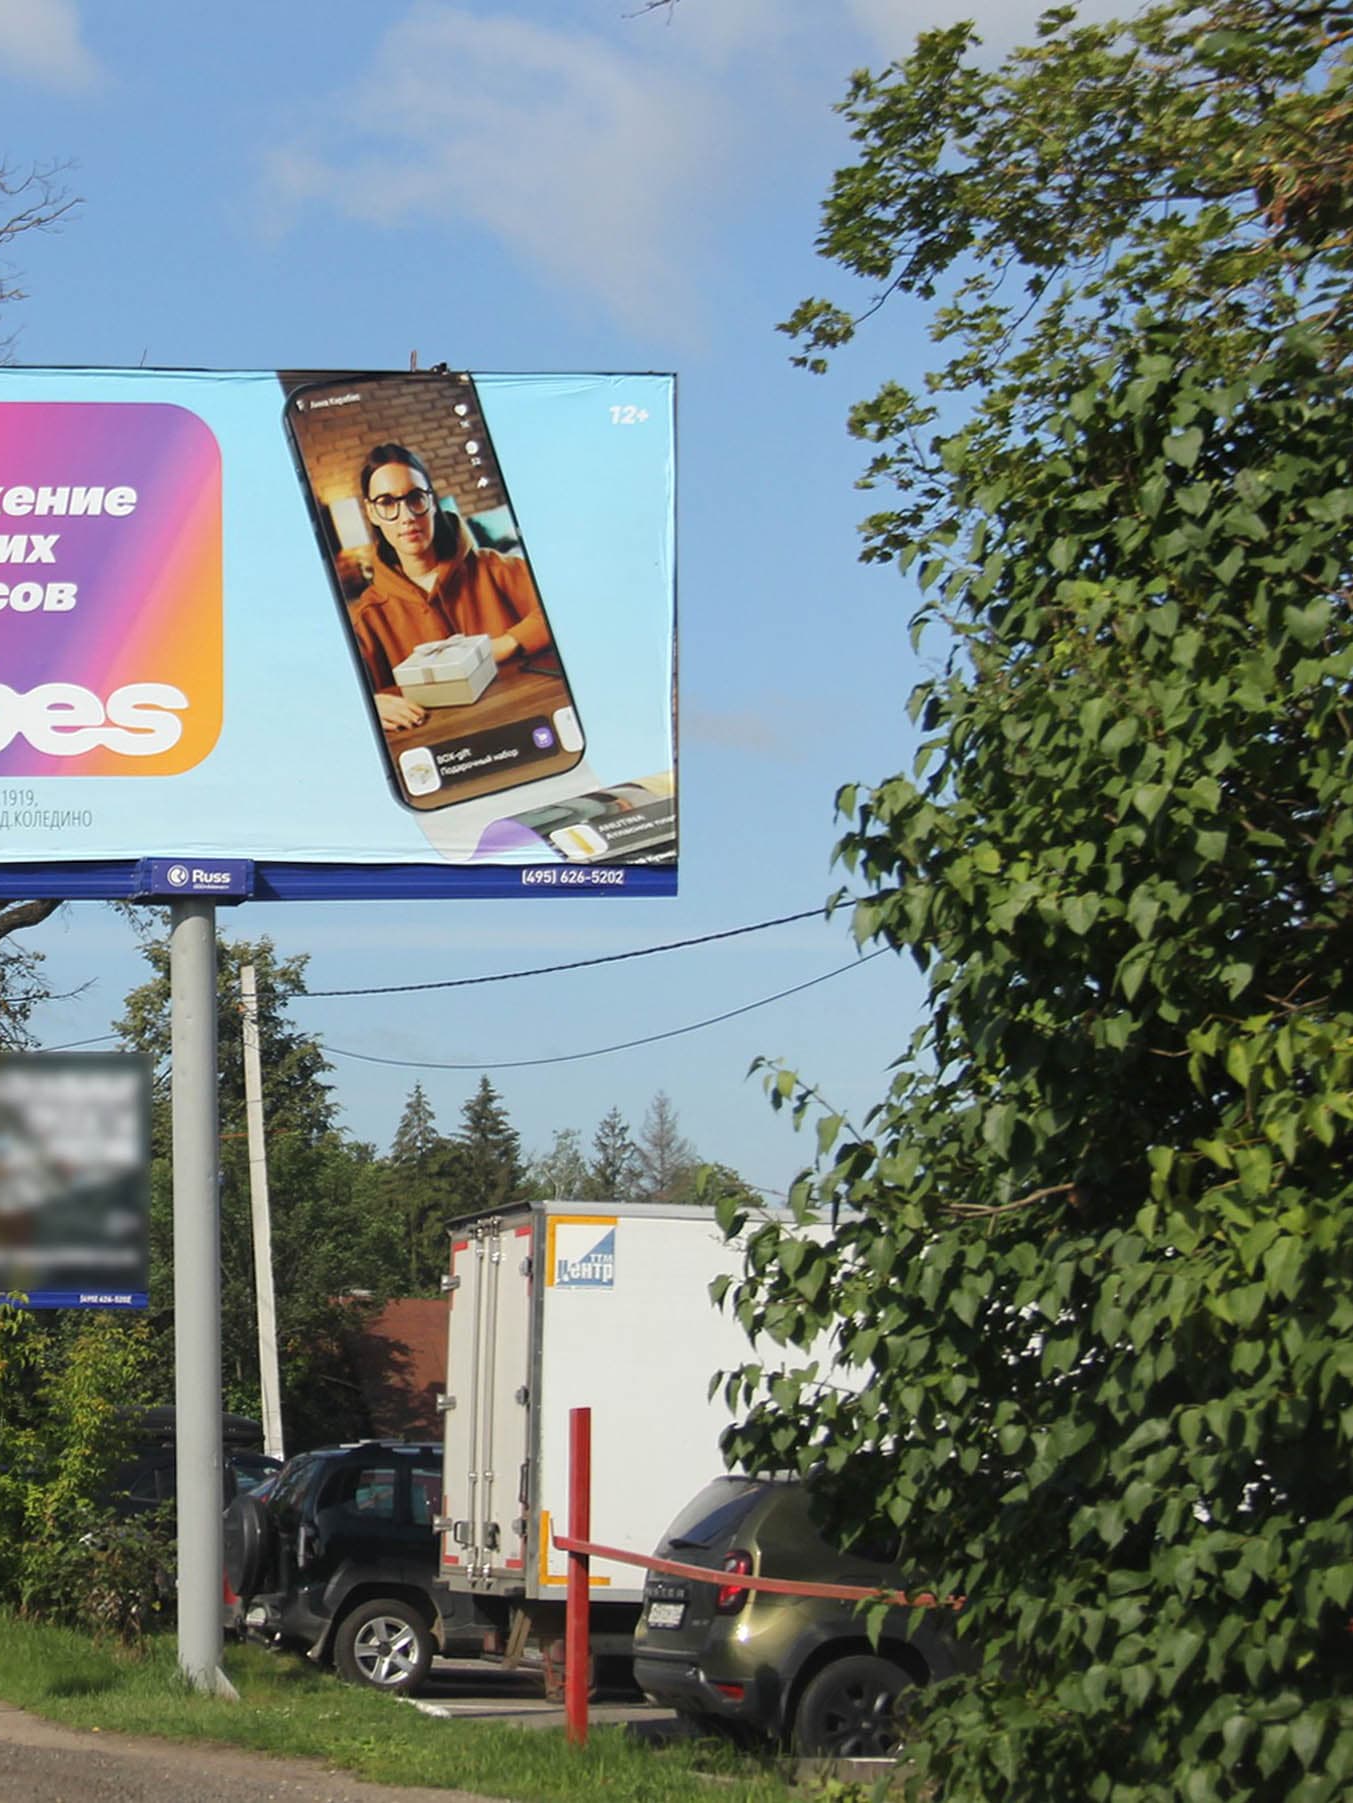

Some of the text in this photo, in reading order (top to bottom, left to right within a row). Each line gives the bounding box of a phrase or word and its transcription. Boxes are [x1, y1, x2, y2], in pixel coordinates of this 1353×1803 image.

[609, 405, 649, 425] 12+
[192, 868, 231, 884] Russ
[522, 870, 624, 885] (495) 626-5202
[557, 1259, 614, 1283] Центр
